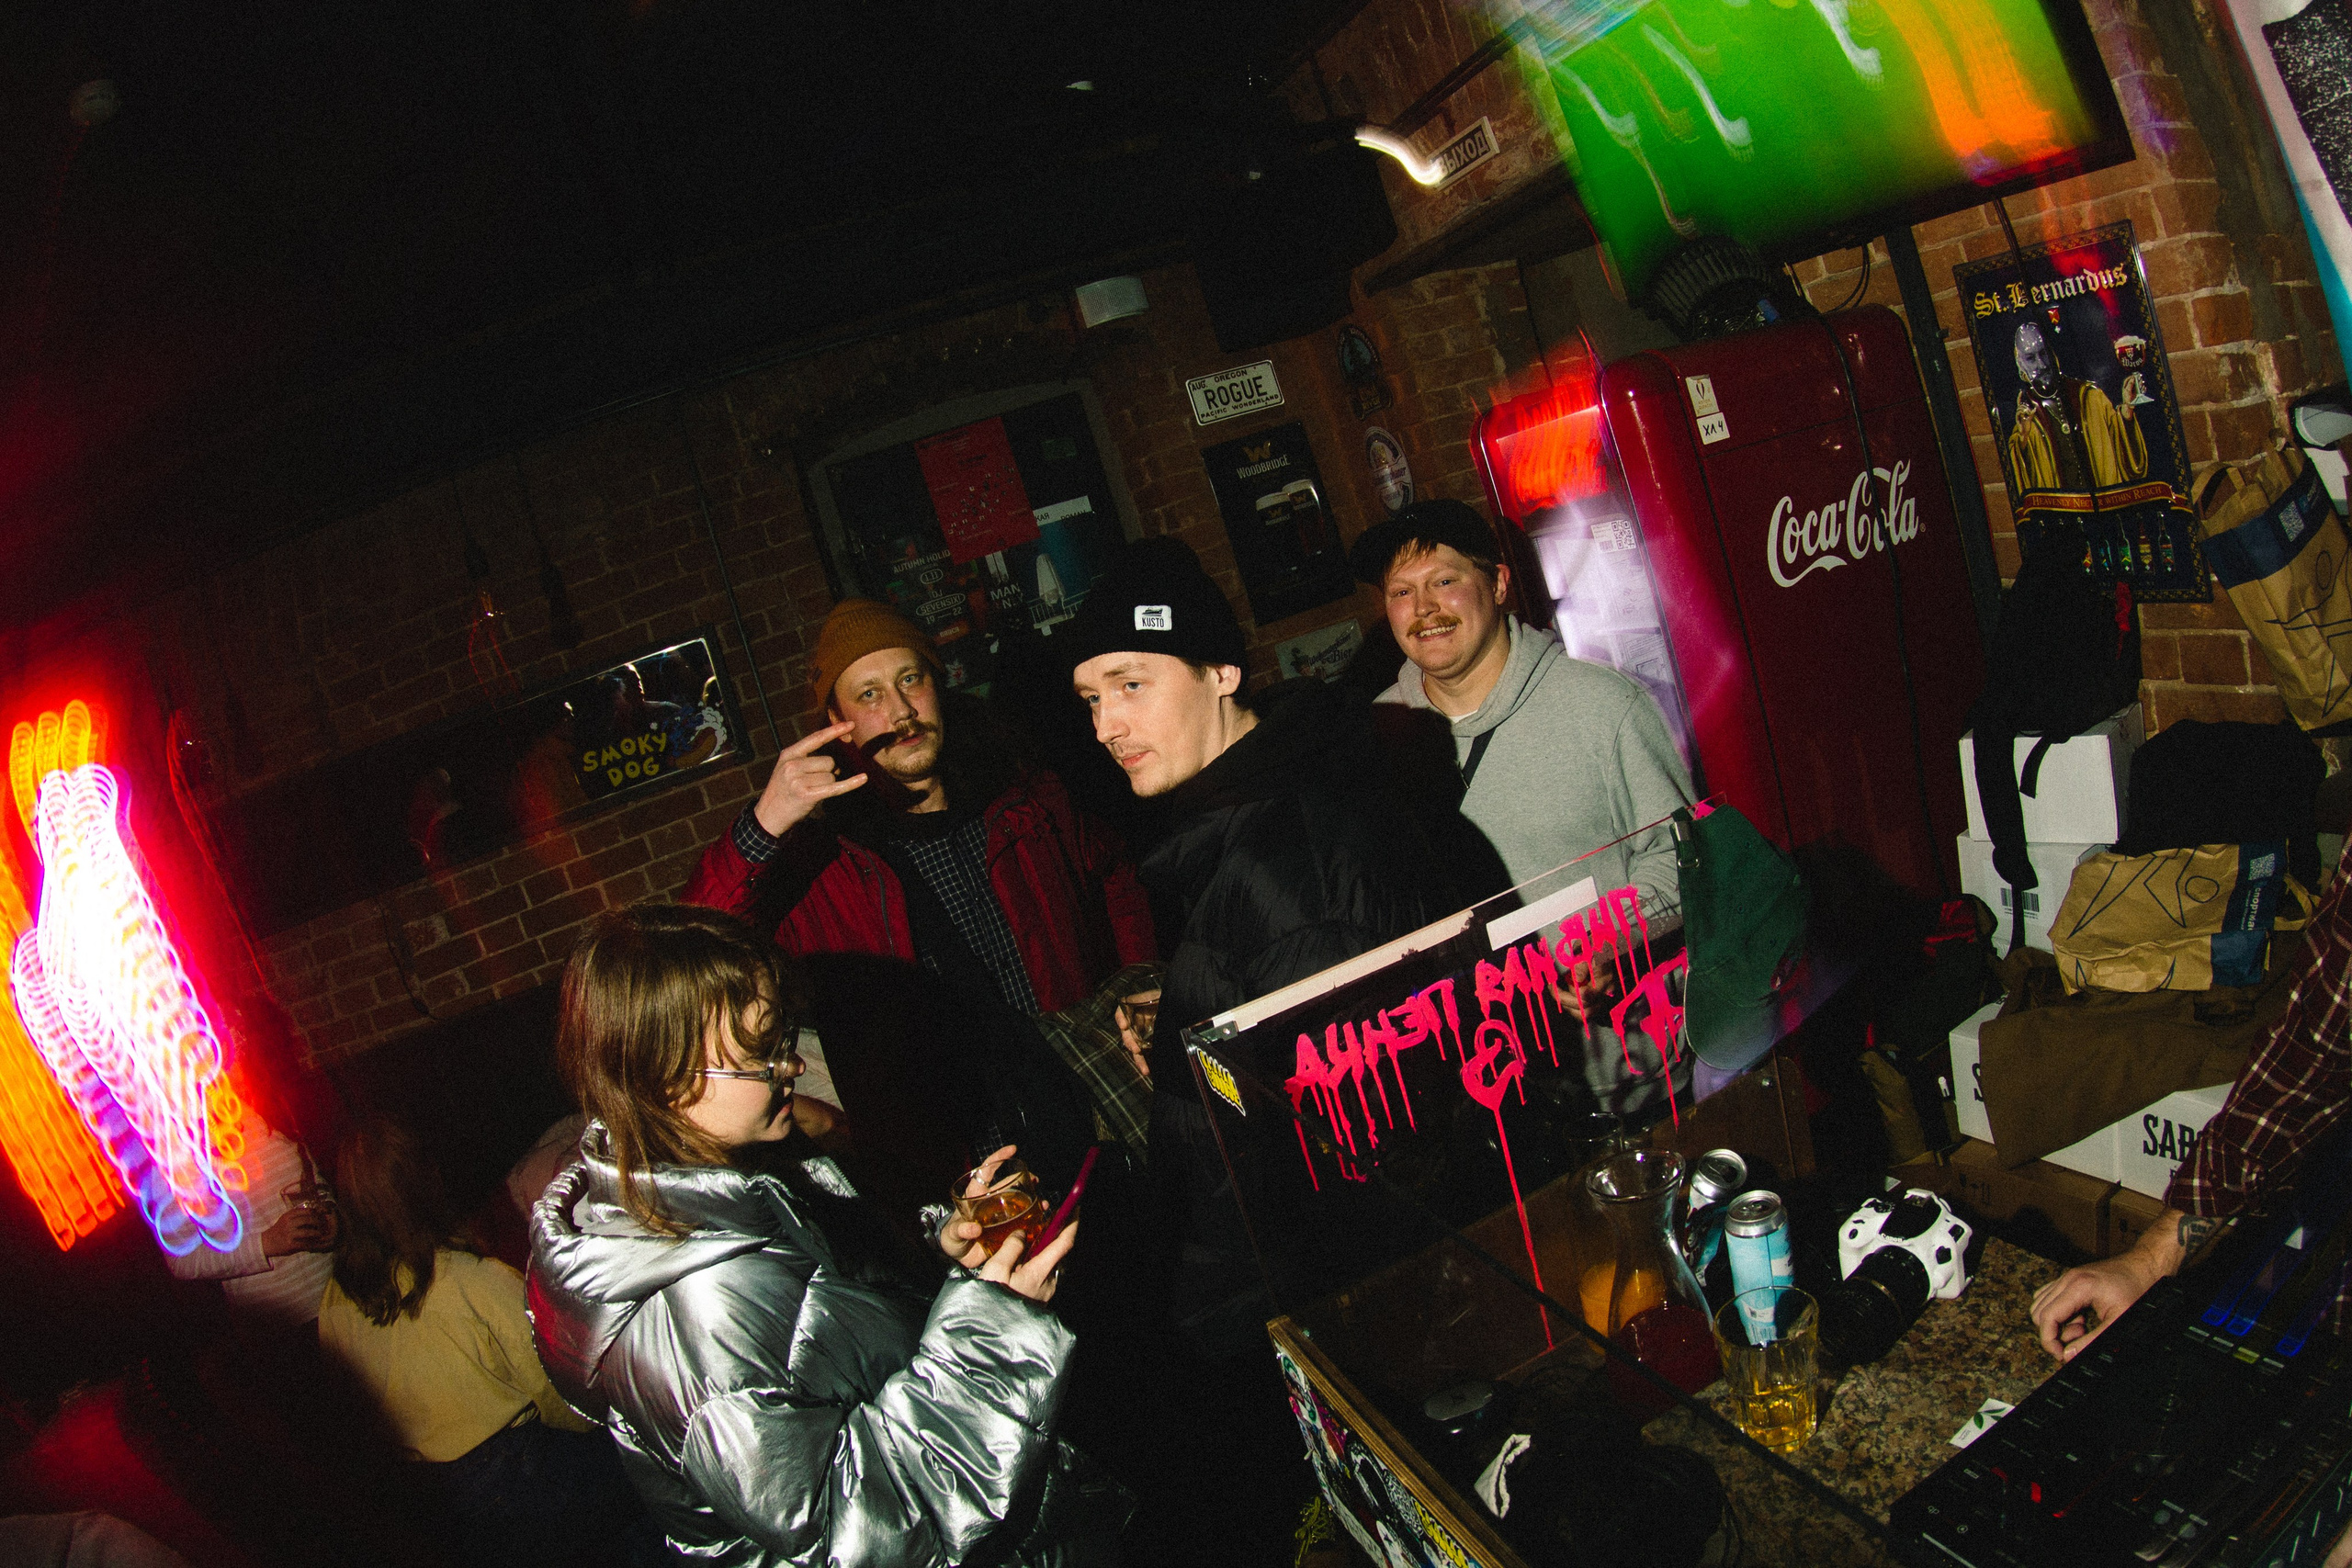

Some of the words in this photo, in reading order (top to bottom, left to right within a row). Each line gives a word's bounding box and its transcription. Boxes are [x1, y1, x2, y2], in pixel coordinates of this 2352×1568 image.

[1438, 130, 1490, 175] ВЫХОД
[1214, 368, 1249, 383] OREGON
[1201, 406, 1227, 419] PACIFIC
[1231, 393, 1280, 412] WONDERLAND
[1204, 375, 1268, 410] ROGUE
[1236, 454, 1291, 480] WOODBRIDGE
[2073, 497, 2104, 508] NECTR
[1767, 458, 1920, 589] Coca-Cola
[893, 554, 927, 575] AUTUMN
[1142, 617, 1165, 628] KUSTO
[582, 732, 668, 773] SMOKY
[606, 756, 661, 788] DOG
[2143, 1113, 2203, 1163] SAB
